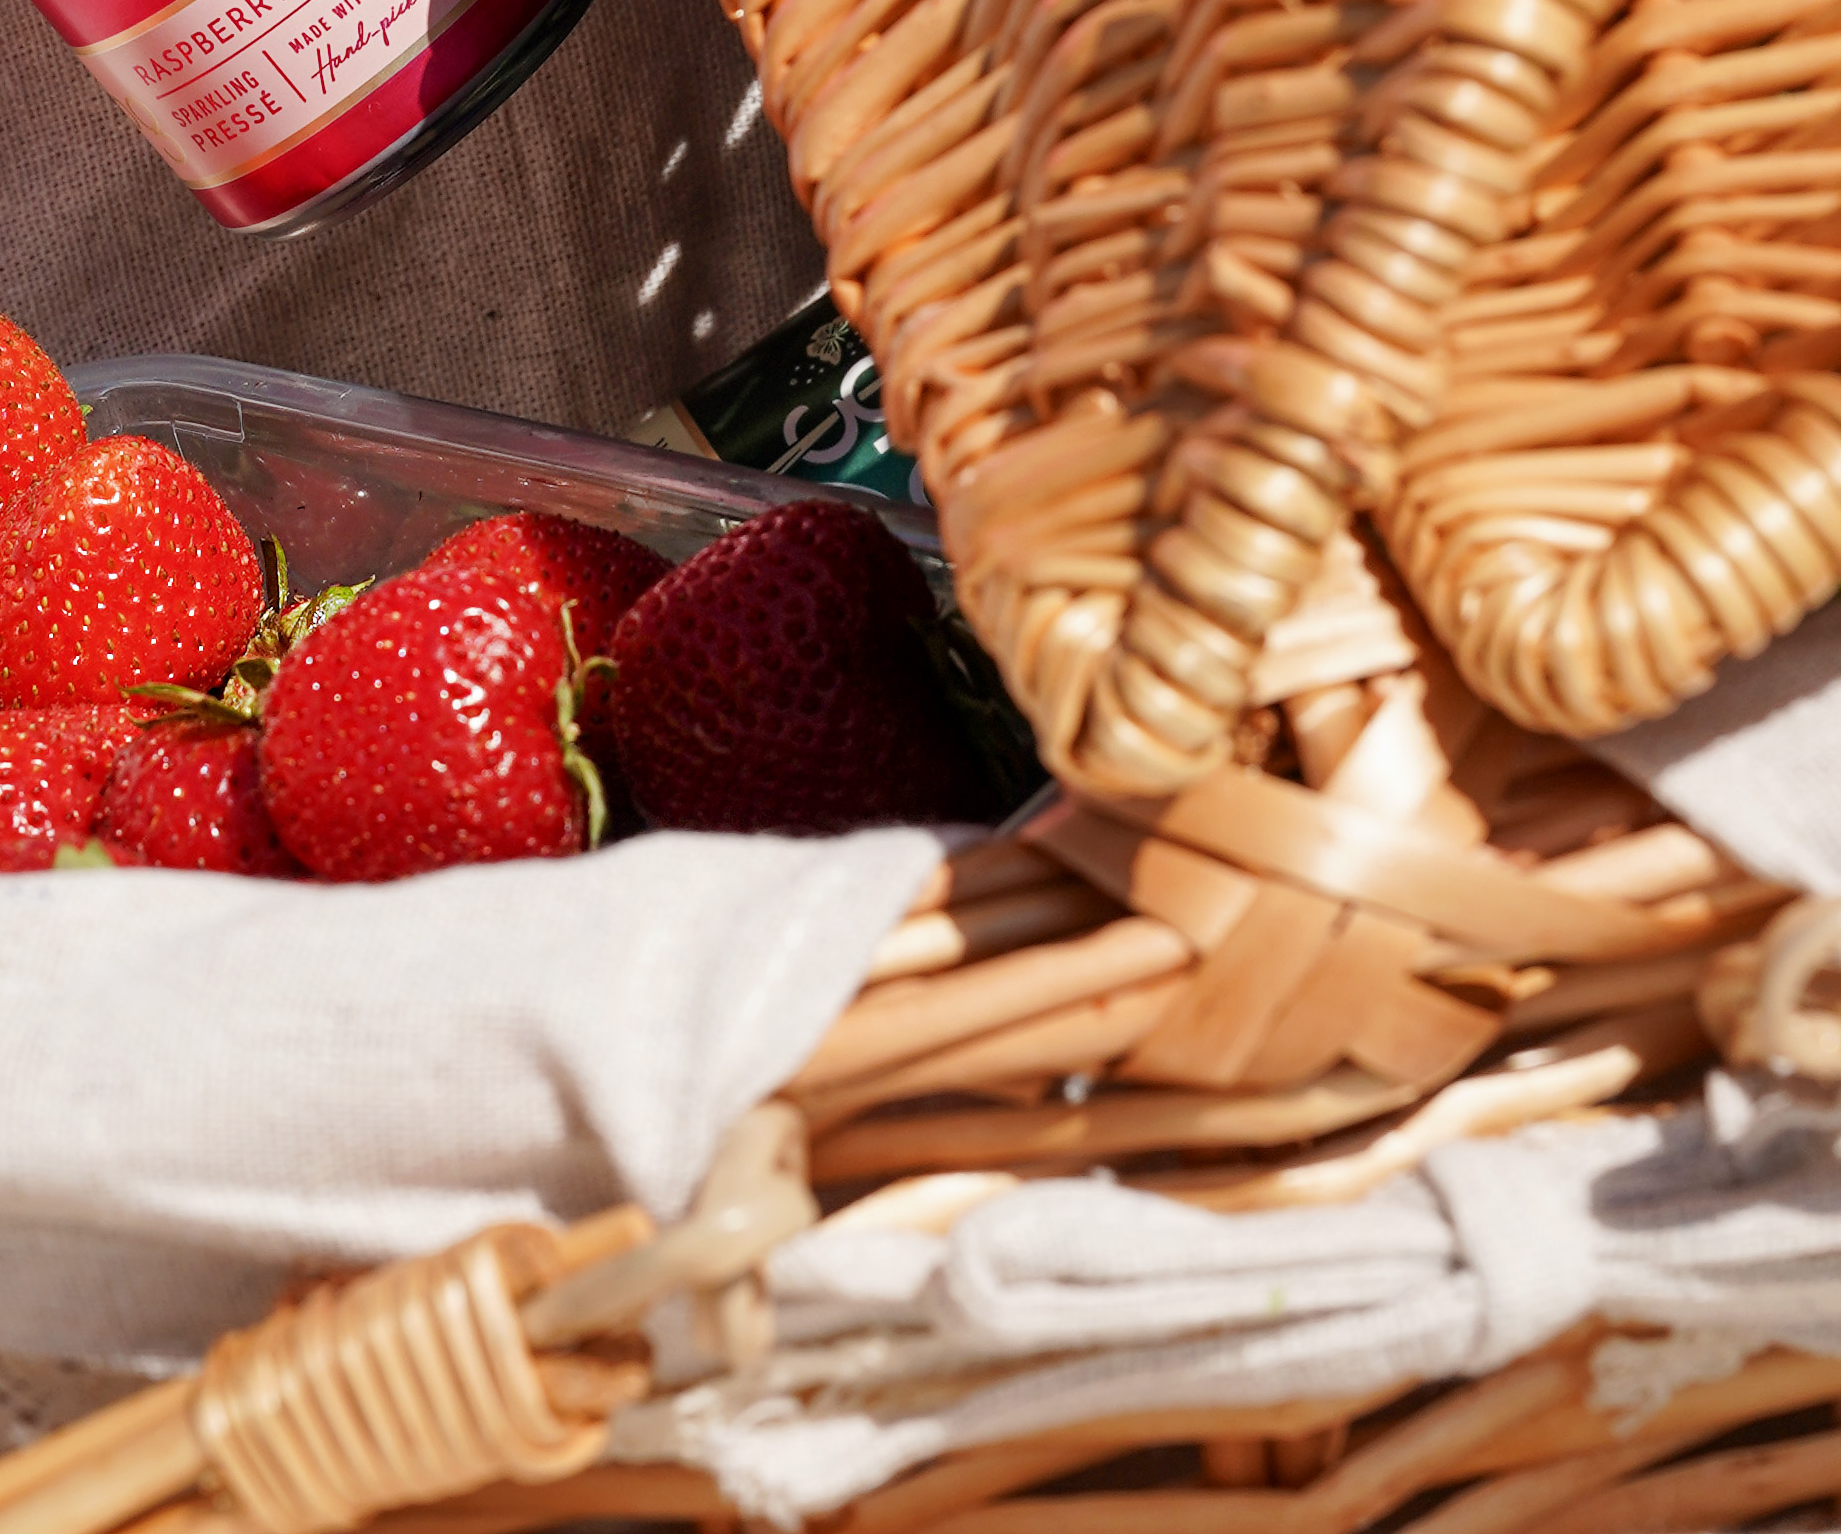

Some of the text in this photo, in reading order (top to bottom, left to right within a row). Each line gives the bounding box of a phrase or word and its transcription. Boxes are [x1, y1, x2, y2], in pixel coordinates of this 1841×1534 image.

[288, 16, 326, 53] MADE
[171, 70, 259, 128] SPARKLING
[190, 89, 283, 152] PRESSÉ
